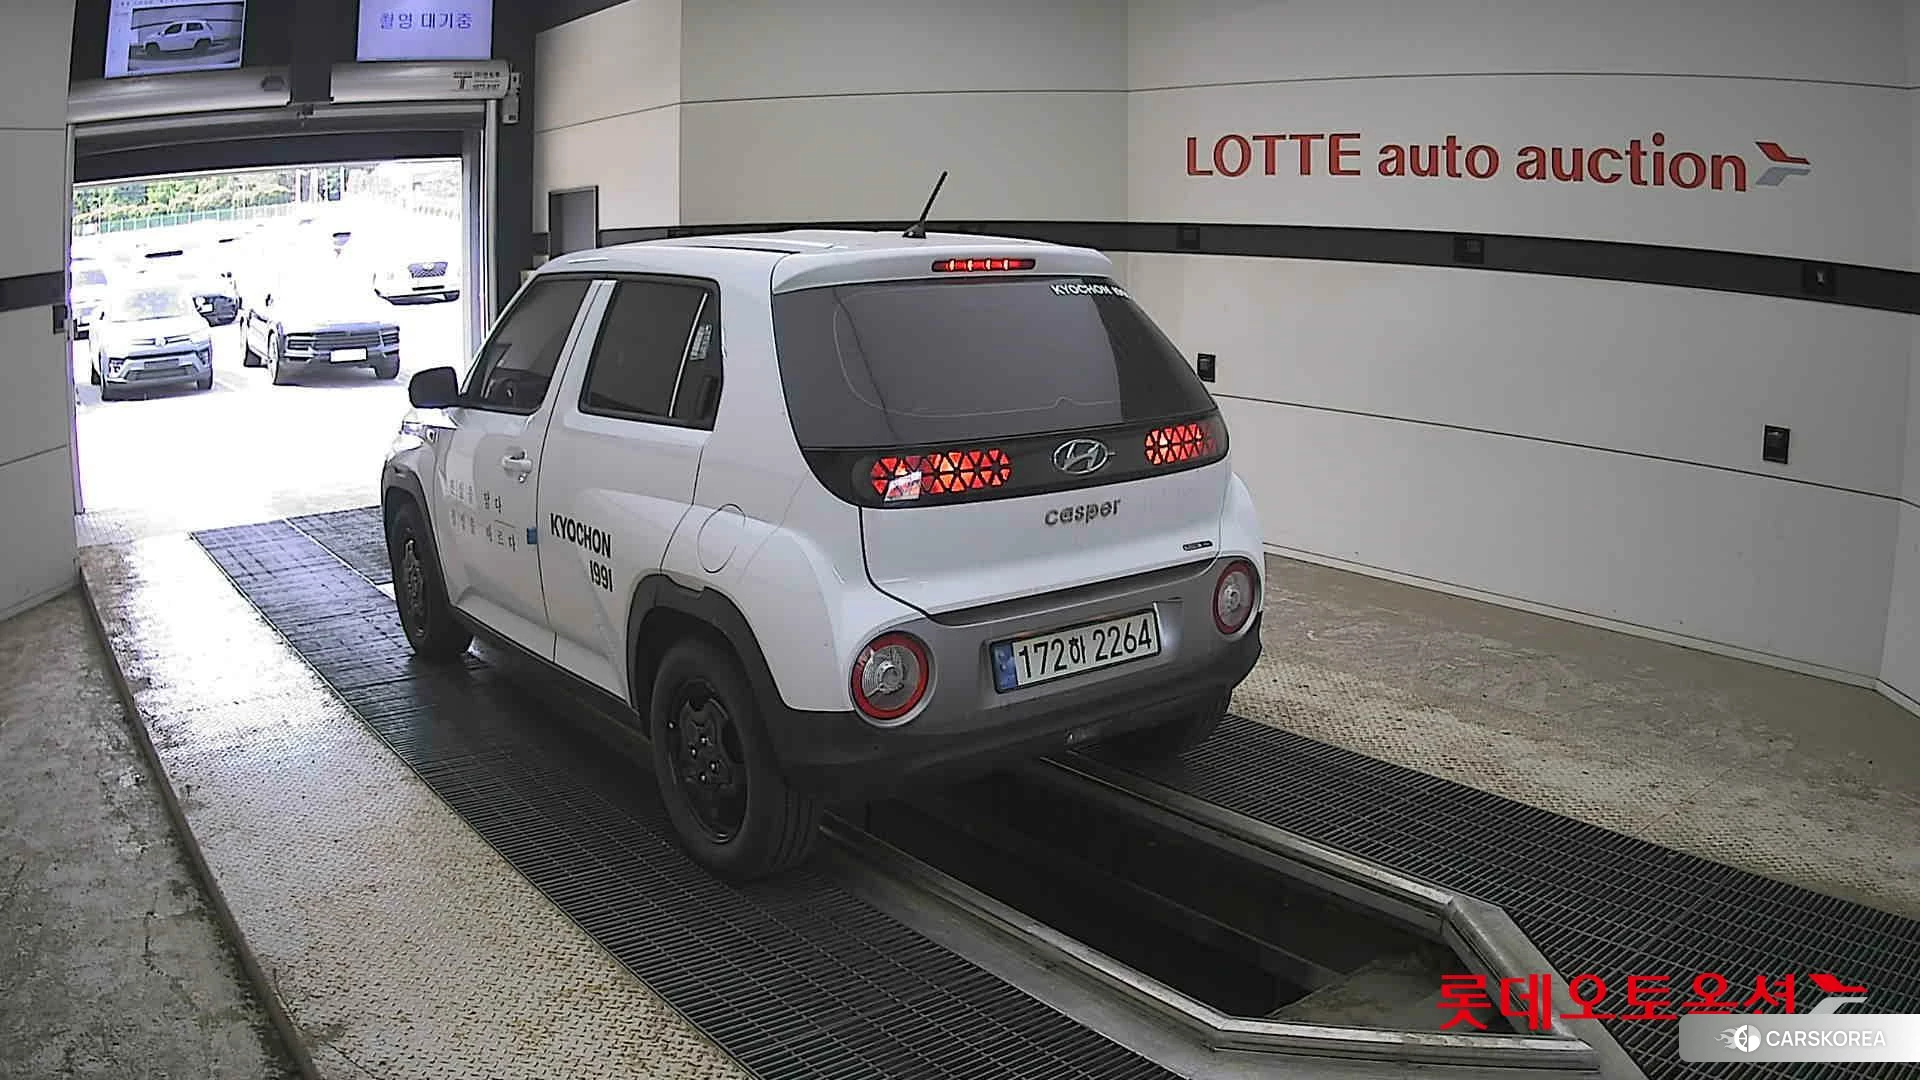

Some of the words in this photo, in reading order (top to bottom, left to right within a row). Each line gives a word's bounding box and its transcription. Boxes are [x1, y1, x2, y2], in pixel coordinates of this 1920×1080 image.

[421, 12, 472, 29] 대기중
[1186, 132, 1362, 177] LOTTE
[1377, 135, 1500, 179] auto
[1516, 132, 1748, 192] auction
[1044, 498, 1121, 526] casper
[550, 513, 612, 559] KYOCHON
[589, 560, 614, 593] 1991
[1092, 618, 1153, 662] 2264
